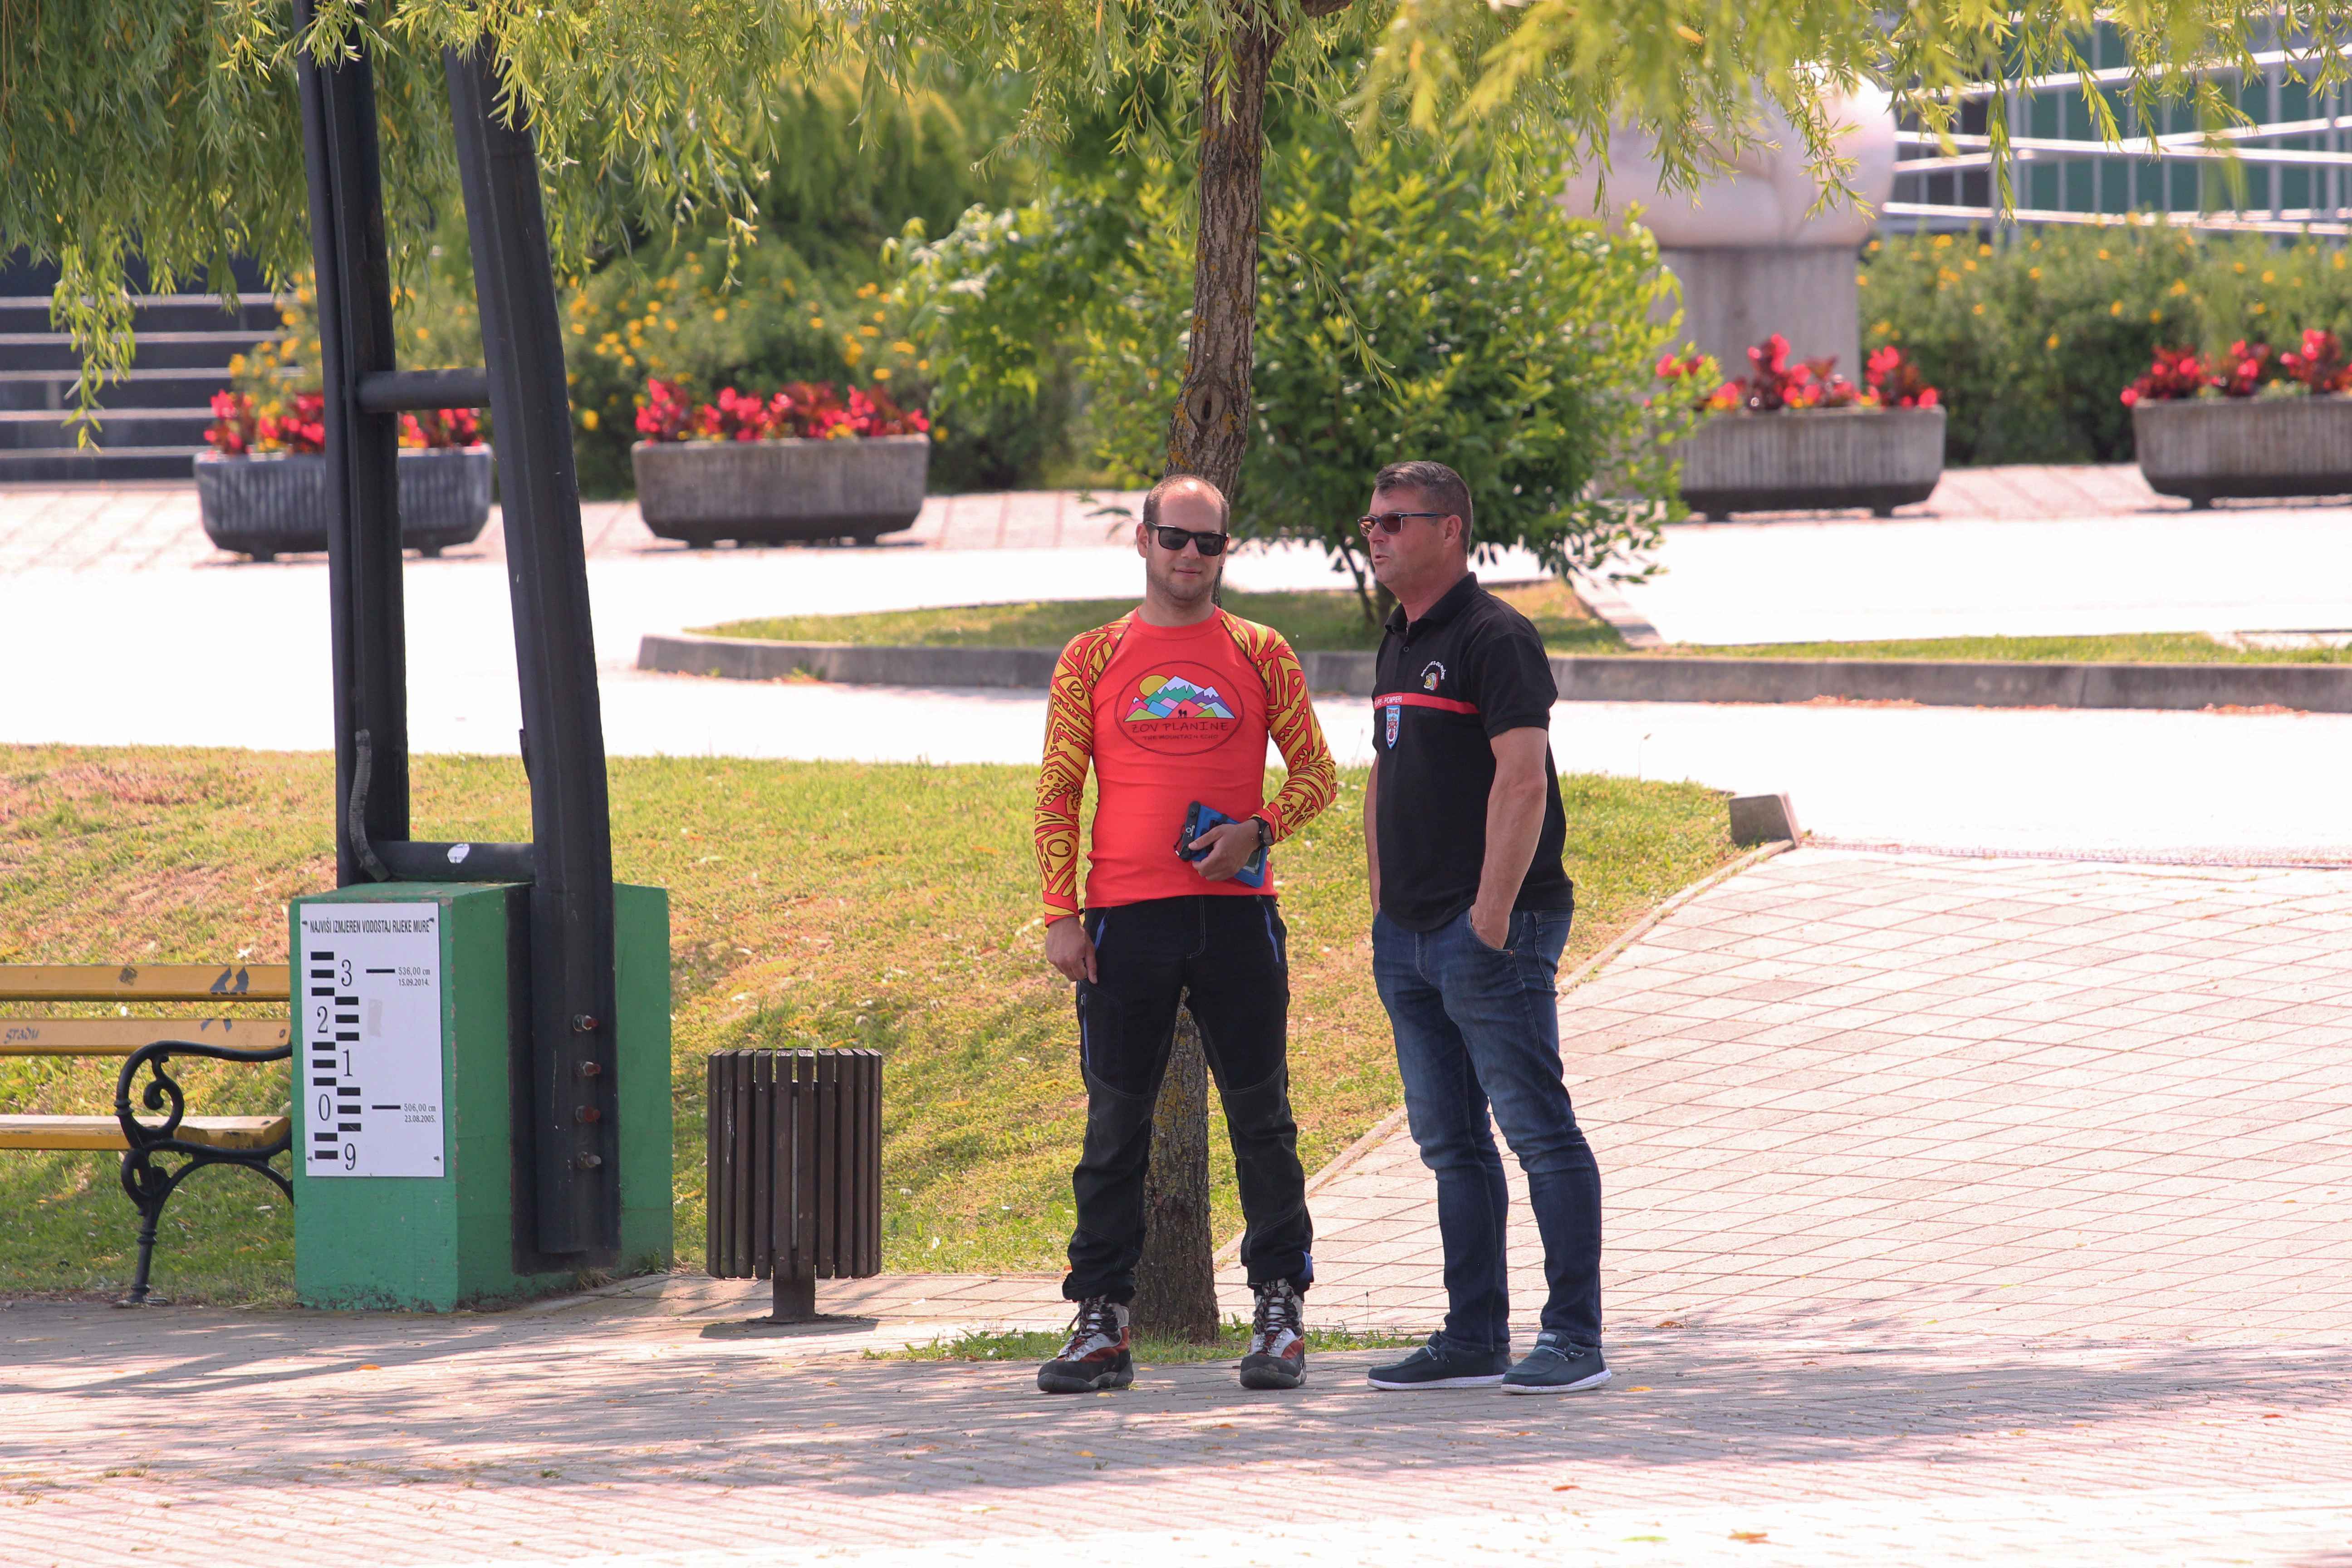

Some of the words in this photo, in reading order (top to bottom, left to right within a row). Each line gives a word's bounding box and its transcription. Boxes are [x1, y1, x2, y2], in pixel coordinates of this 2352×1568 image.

[1132, 723, 1158, 733] ZOV
[1162, 721, 1229, 731] PLANINE
[310, 917, 332, 933] NAJVIŠI
[333, 920, 361, 933] IZMJEREN
[362, 919, 391, 933] VODOSTAJ
[392, 919, 412, 933] RIJEKE
[413, 919, 430, 933] MURE
[341, 959, 352, 986] 3
[398, 966, 421, 976] 536,00
[317, 1006, 328, 1033] 2
[343, 1049, 353, 1077] 1
[318, 1093, 331, 1121] 0
[404, 1103, 427, 1113] 506,00
[344, 1143, 356, 1171] 9
